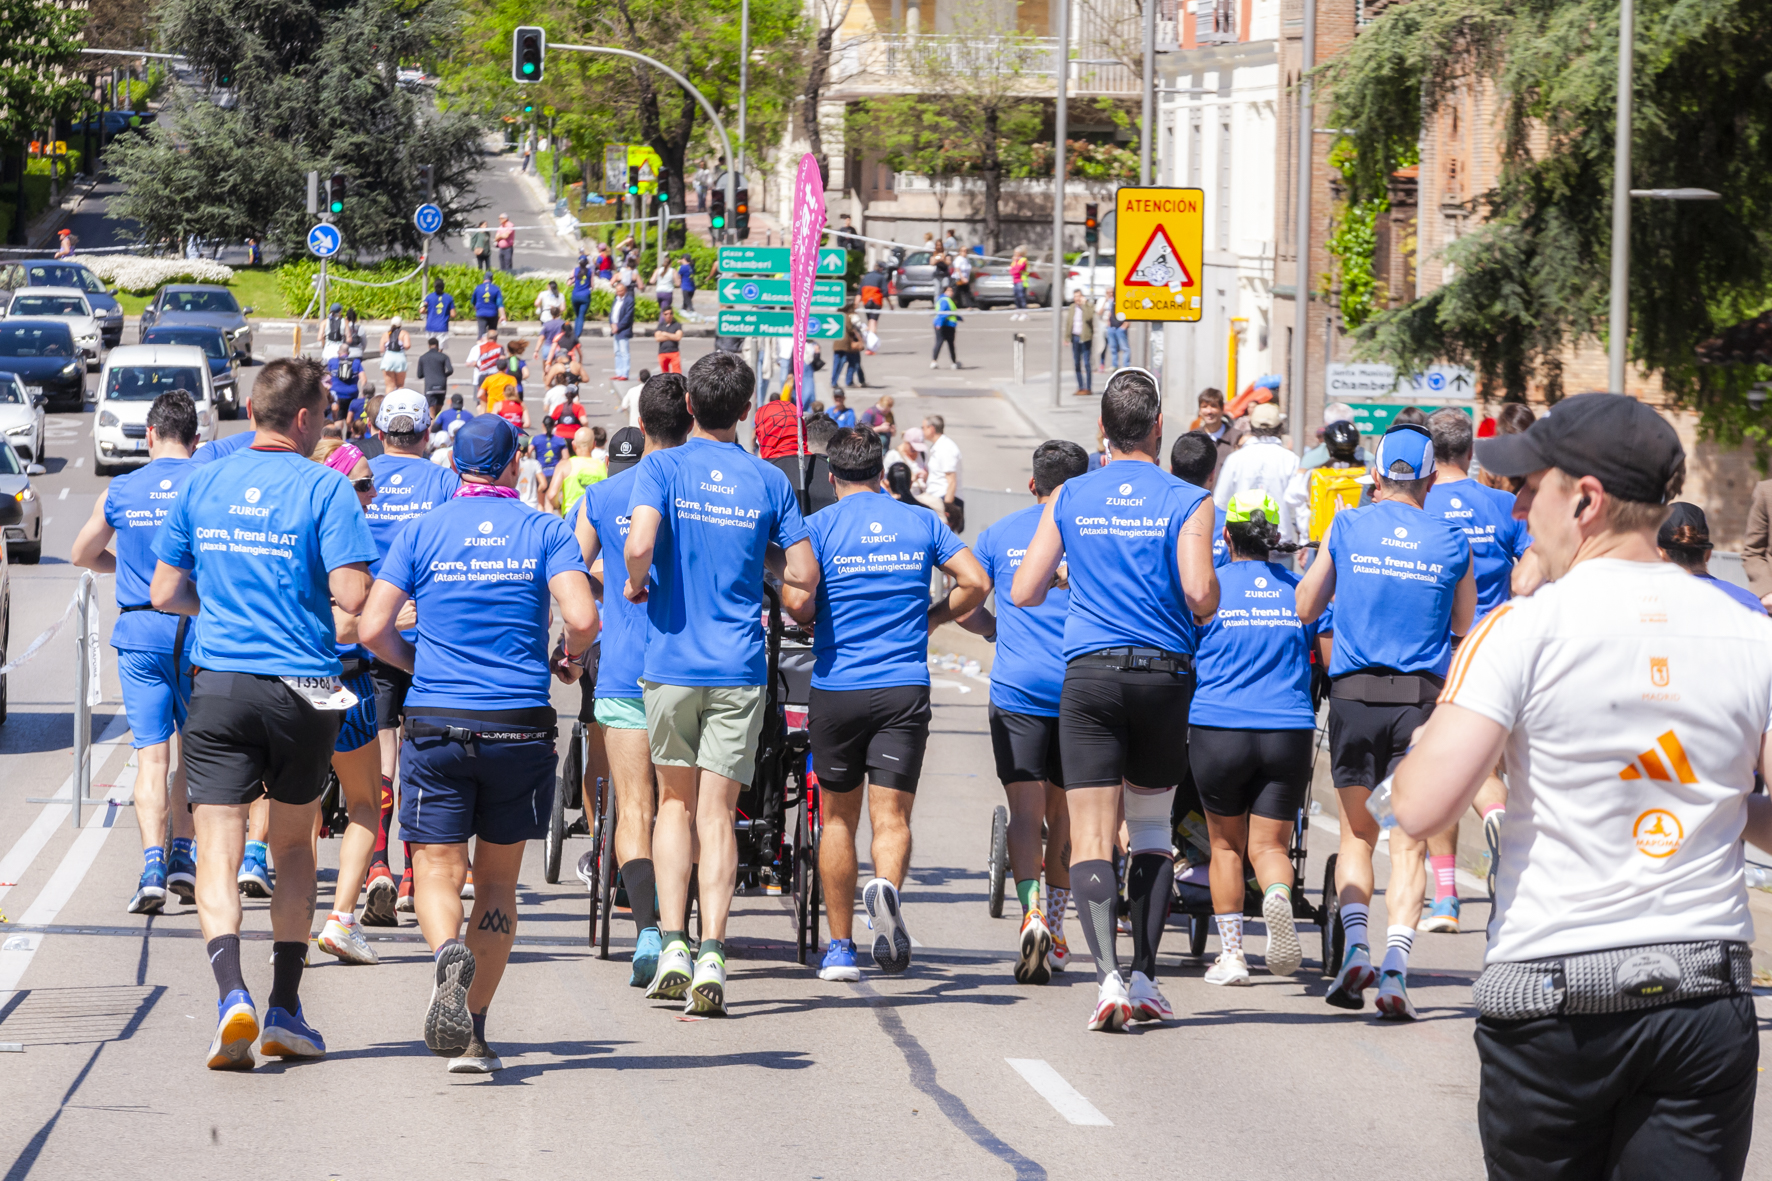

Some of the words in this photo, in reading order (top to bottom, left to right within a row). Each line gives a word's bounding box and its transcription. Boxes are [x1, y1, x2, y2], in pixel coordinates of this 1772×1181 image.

[1126, 198, 1197, 213] ATENCIÓN
[1123, 300, 1194, 311] CICOCARRIL
[721, 323, 755, 332] Doctor
[1332, 380, 1394, 390] Chamber
[700, 482, 734, 495] ZURICH
[367, 504, 380, 512] re,
[383, 503, 409, 512] frena
[410, 502, 419, 510] la
[421, 502, 433, 510] AT
[1106, 498, 1143, 506] ZURICH
[125, 510, 153, 518] Corre,
[229, 505, 270, 517] ZURICH
[675, 498, 702, 511] Corre,
[705, 502, 732, 515] frena
[735, 506, 745, 516] la
[747, 509, 761, 520] AT
[678, 510, 701, 521] (Ataxia
[702, 514, 755, 530] telangiectasia)
[1444, 511, 1472, 519] ZURICH
[1075, 516, 1108, 526] Corre,
[1111, 516, 1140, 526] frena
[1143, 517, 1154, 526] la
[1155, 518, 1169, 526] AT
[1080, 527, 1108, 537] (Ataxia
[1109, 528, 1165, 538] telangiectasia)
[1485, 525, 1496, 534] AT
[196, 527, 231, 541] Corre,
[234, 528, 266, 542] frena
[268, 531, 278, 543] la
[280, 534, 298, 546] AT
[464, 538, 506, 546] ZURICH
[861, 535, 896, 544] ZURICH
[200, 542, 227, 553] (Ataxia
[1381, 538, 1417, 550] ZURICH
[833, 556, 865, 565] Corre,
[868, 553, 897, 563] frena
[900, 552, 910, 561] la
[912, 552, 925, 561] AT
[1351, 553, 1382, 565] Corre,
[1385, 557, 1414, 569] frena
[1417, 561, 1427, 571] la
[1429, 564, 1443, 574] AT
[431, 561, 467, 571] Corre,
[470, 559, 504, 570] frena
[507, 558, 519, 569] la
[522, 559, 537, 569] AT
[838, 565, 865, 575] (Ataxia
[867, 563, 922, 572] telangiectasia)
[434, 572, 465, 583] (Ataxia
[467, 572, 534, 583] telangiectasia)
[1353, 565, 1380, 574] (Ataxia
[1382, 568, 1437, 584] telangiectasia)
[1245, 590, 1280, 598] ZURICH
[1218, 609, 1249, 618] Corre,
[1251, 607, 1280, 617] frena
[1282, 608, 1291, 617] la
[1223, 619, 1249, 628] (Ataxia
[1250, 618, 1302, 628] telangiectasia)
[1642, 693, 1681, 702] MADRID
